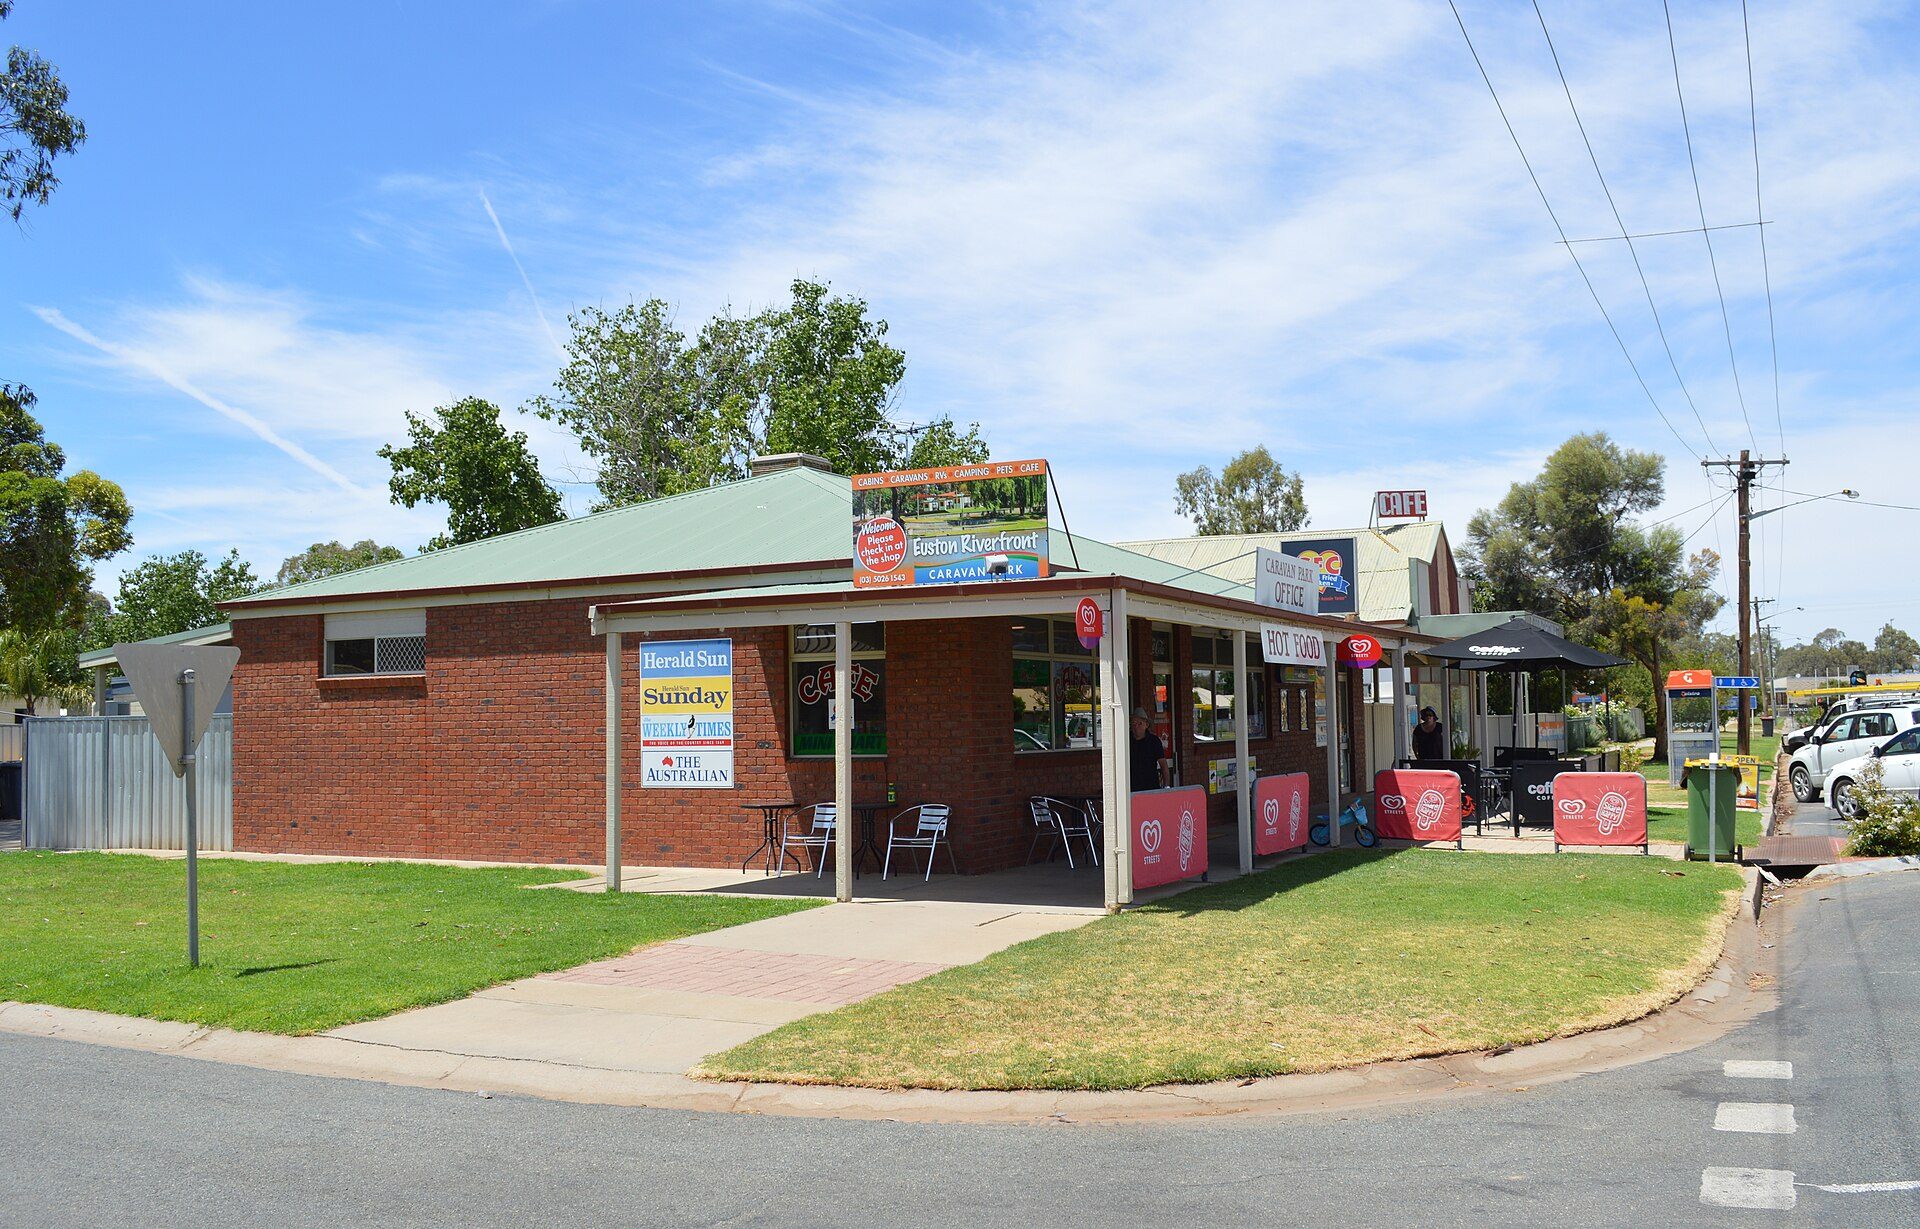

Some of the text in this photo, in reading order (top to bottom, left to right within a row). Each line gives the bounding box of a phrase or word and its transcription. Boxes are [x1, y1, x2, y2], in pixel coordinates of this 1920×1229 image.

[858, 463, 1040, 486] CABINS CARAVANS RVs CAMPING PETS CAFE
[1379, 492, 1427, 516] CAFE
[860, 522, 897, 536] Welcome
[867, 534, 894, 546] Please
[914, 531, 1039, 558] Euston Riverfront
[860, 541, 904, 558] check in at
[866, 552, 901, 566] the shop
[929, 566, 986, 580] CARAVAN
[1266, 558, 1314, 584] CARAVAN PARK
[859, 574, 906, 584] (03) 5026 1543
[1274, 581, 1304, 608] OFFICE
[1266, 630, 1320, 660] HOT FOOD
[644, 650, 728, 670] Herald Sun
[644, 687, 729, 709] Sunday
[642, 722, 732, 737] WEEKLY TIMES
[800, 735, 885, 750] MINI ART
[676, 756, 700, 768] THE
[646, 768, 728, 782] AUSTRALIAN
[1528, 782, 1554, 794] coff
[1265, 828, 1277, 836] STREETS
[1144, 854, 1160, 864] STREETS
